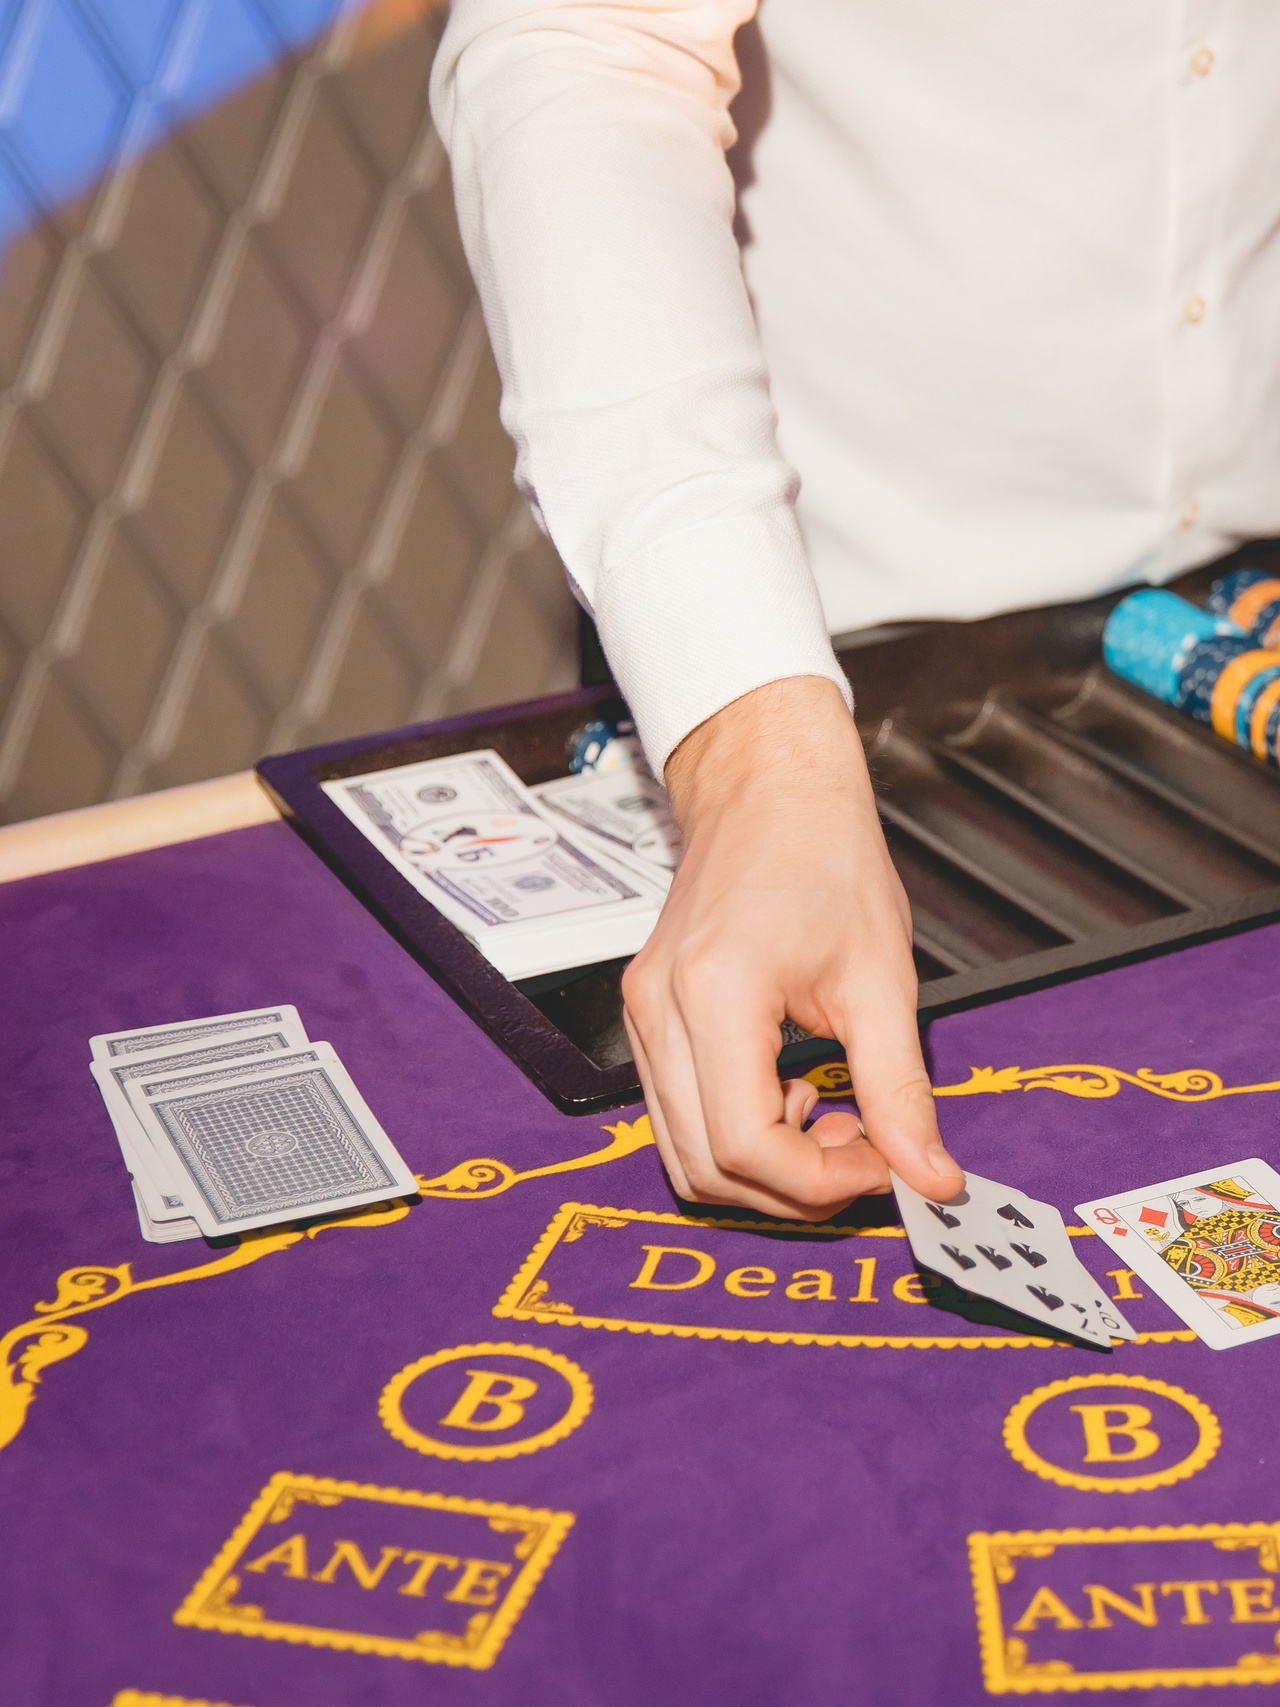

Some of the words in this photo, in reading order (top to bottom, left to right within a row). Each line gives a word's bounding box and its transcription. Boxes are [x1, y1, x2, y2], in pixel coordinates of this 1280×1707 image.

[1093, 1207, 1121, 1225] Q
[629, 1245, 946, 1304] Deale
[440, 1370, 538, 1432] B
[1070, 1404, 1161, 1463] B
[246, 1535, 512, 1606] ANTE
